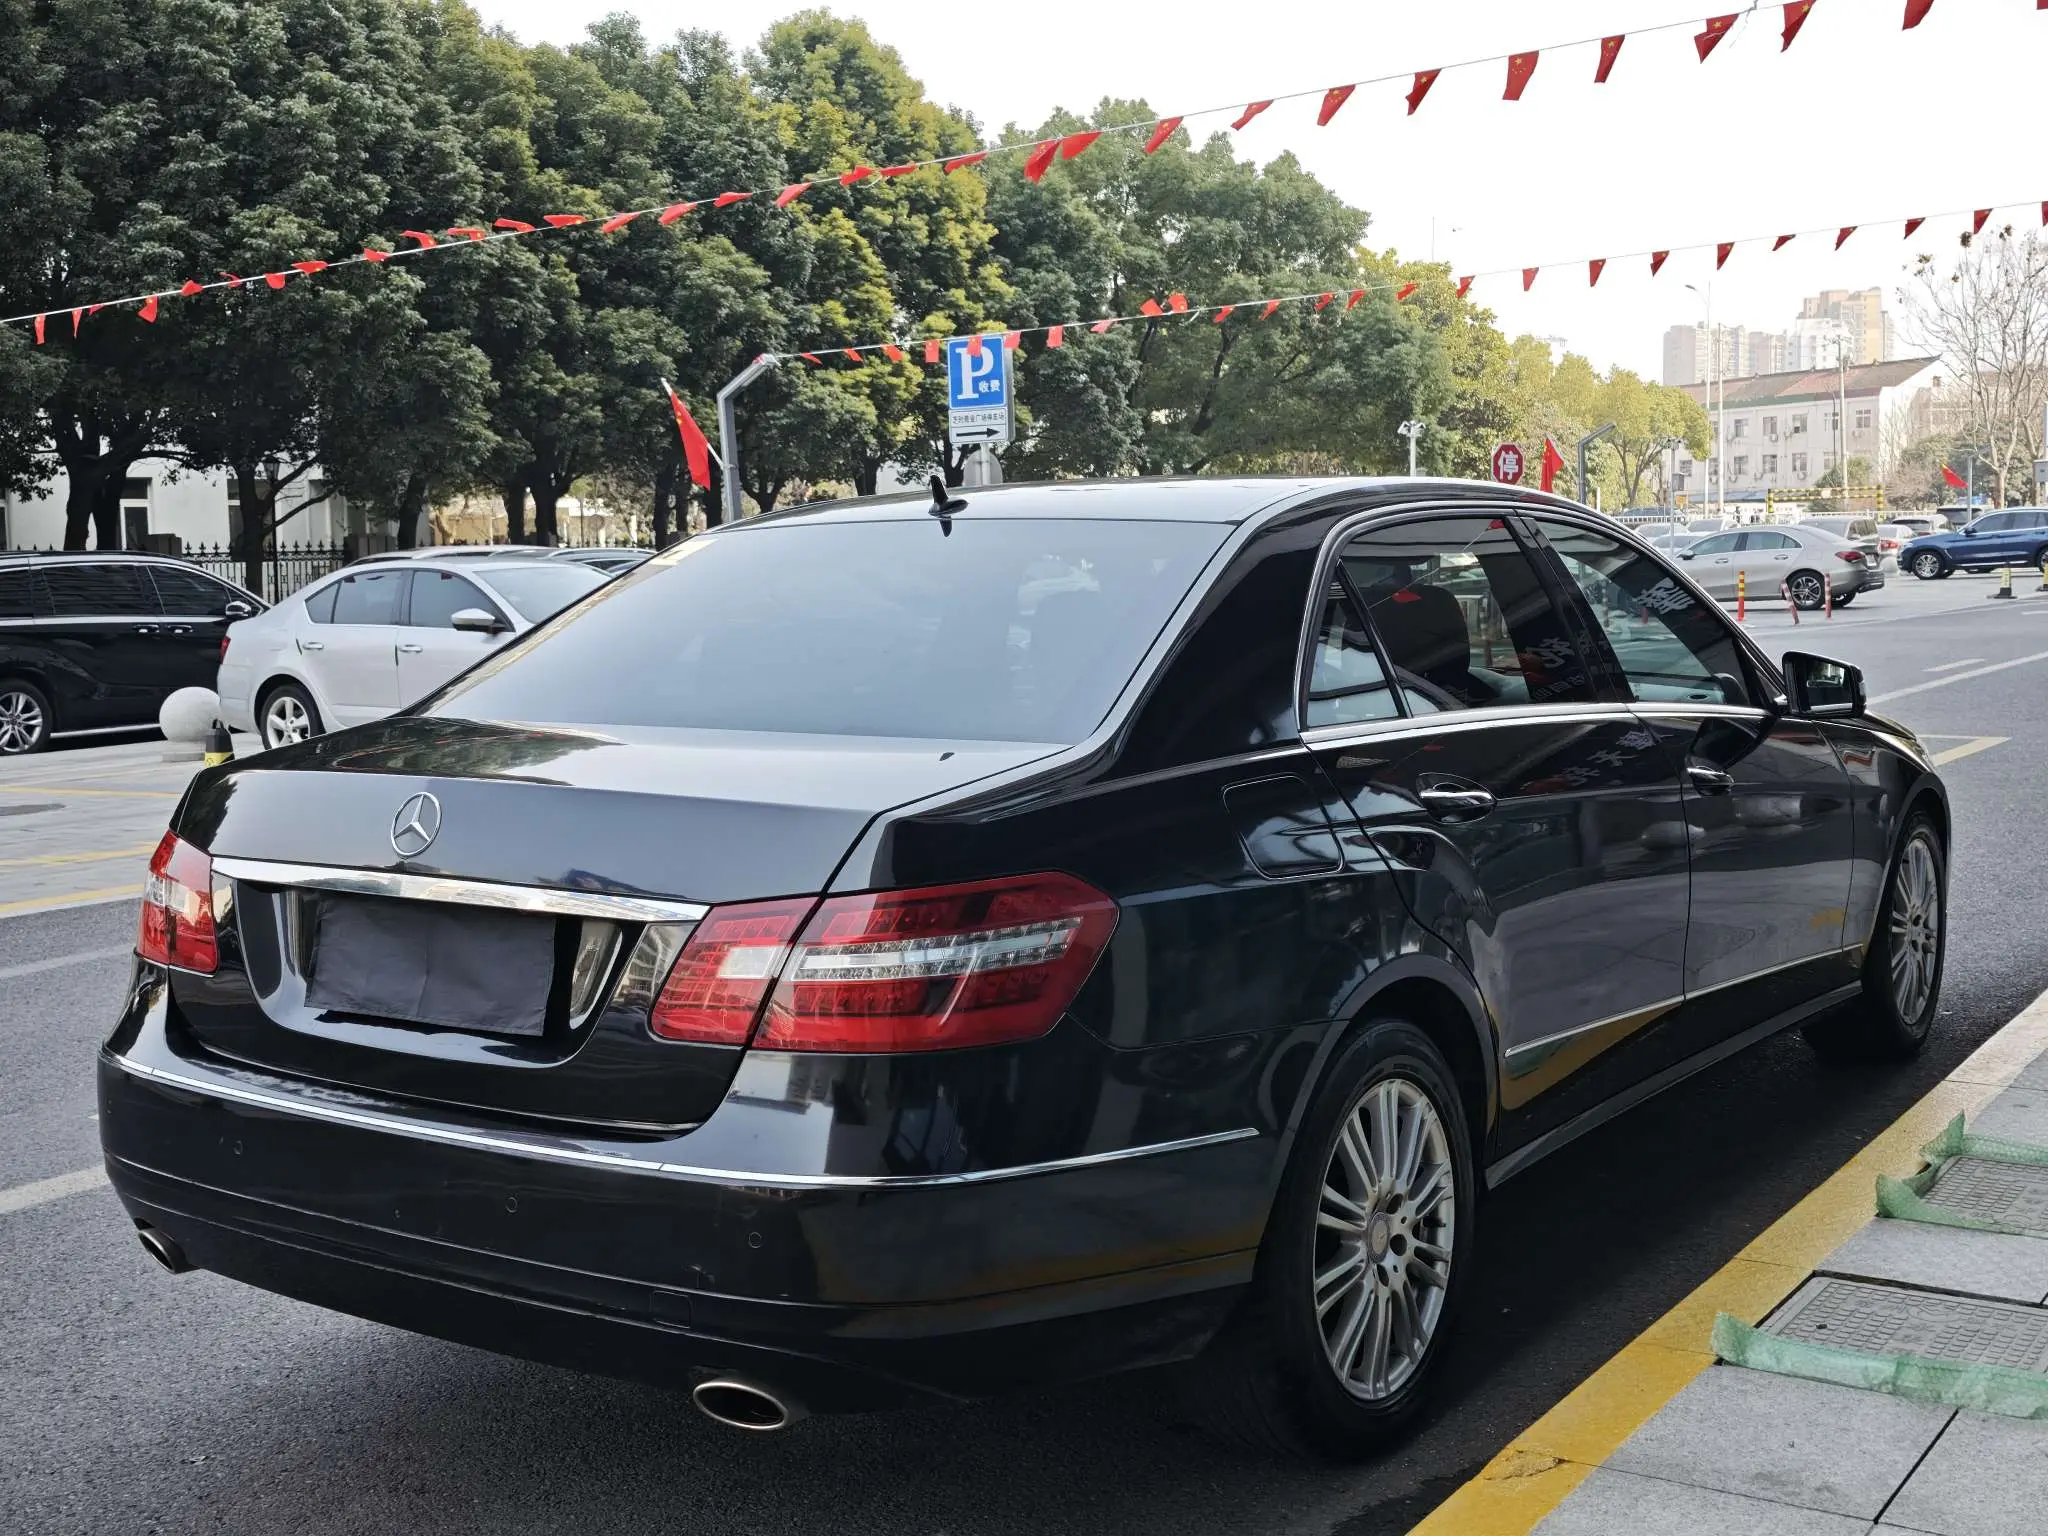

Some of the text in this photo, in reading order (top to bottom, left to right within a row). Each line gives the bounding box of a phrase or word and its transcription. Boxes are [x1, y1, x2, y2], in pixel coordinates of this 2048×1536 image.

[955, 347, 994, 400] P
[979, 379, 1000, 393] 收费
[1497, 450, 1519, 480] 停
